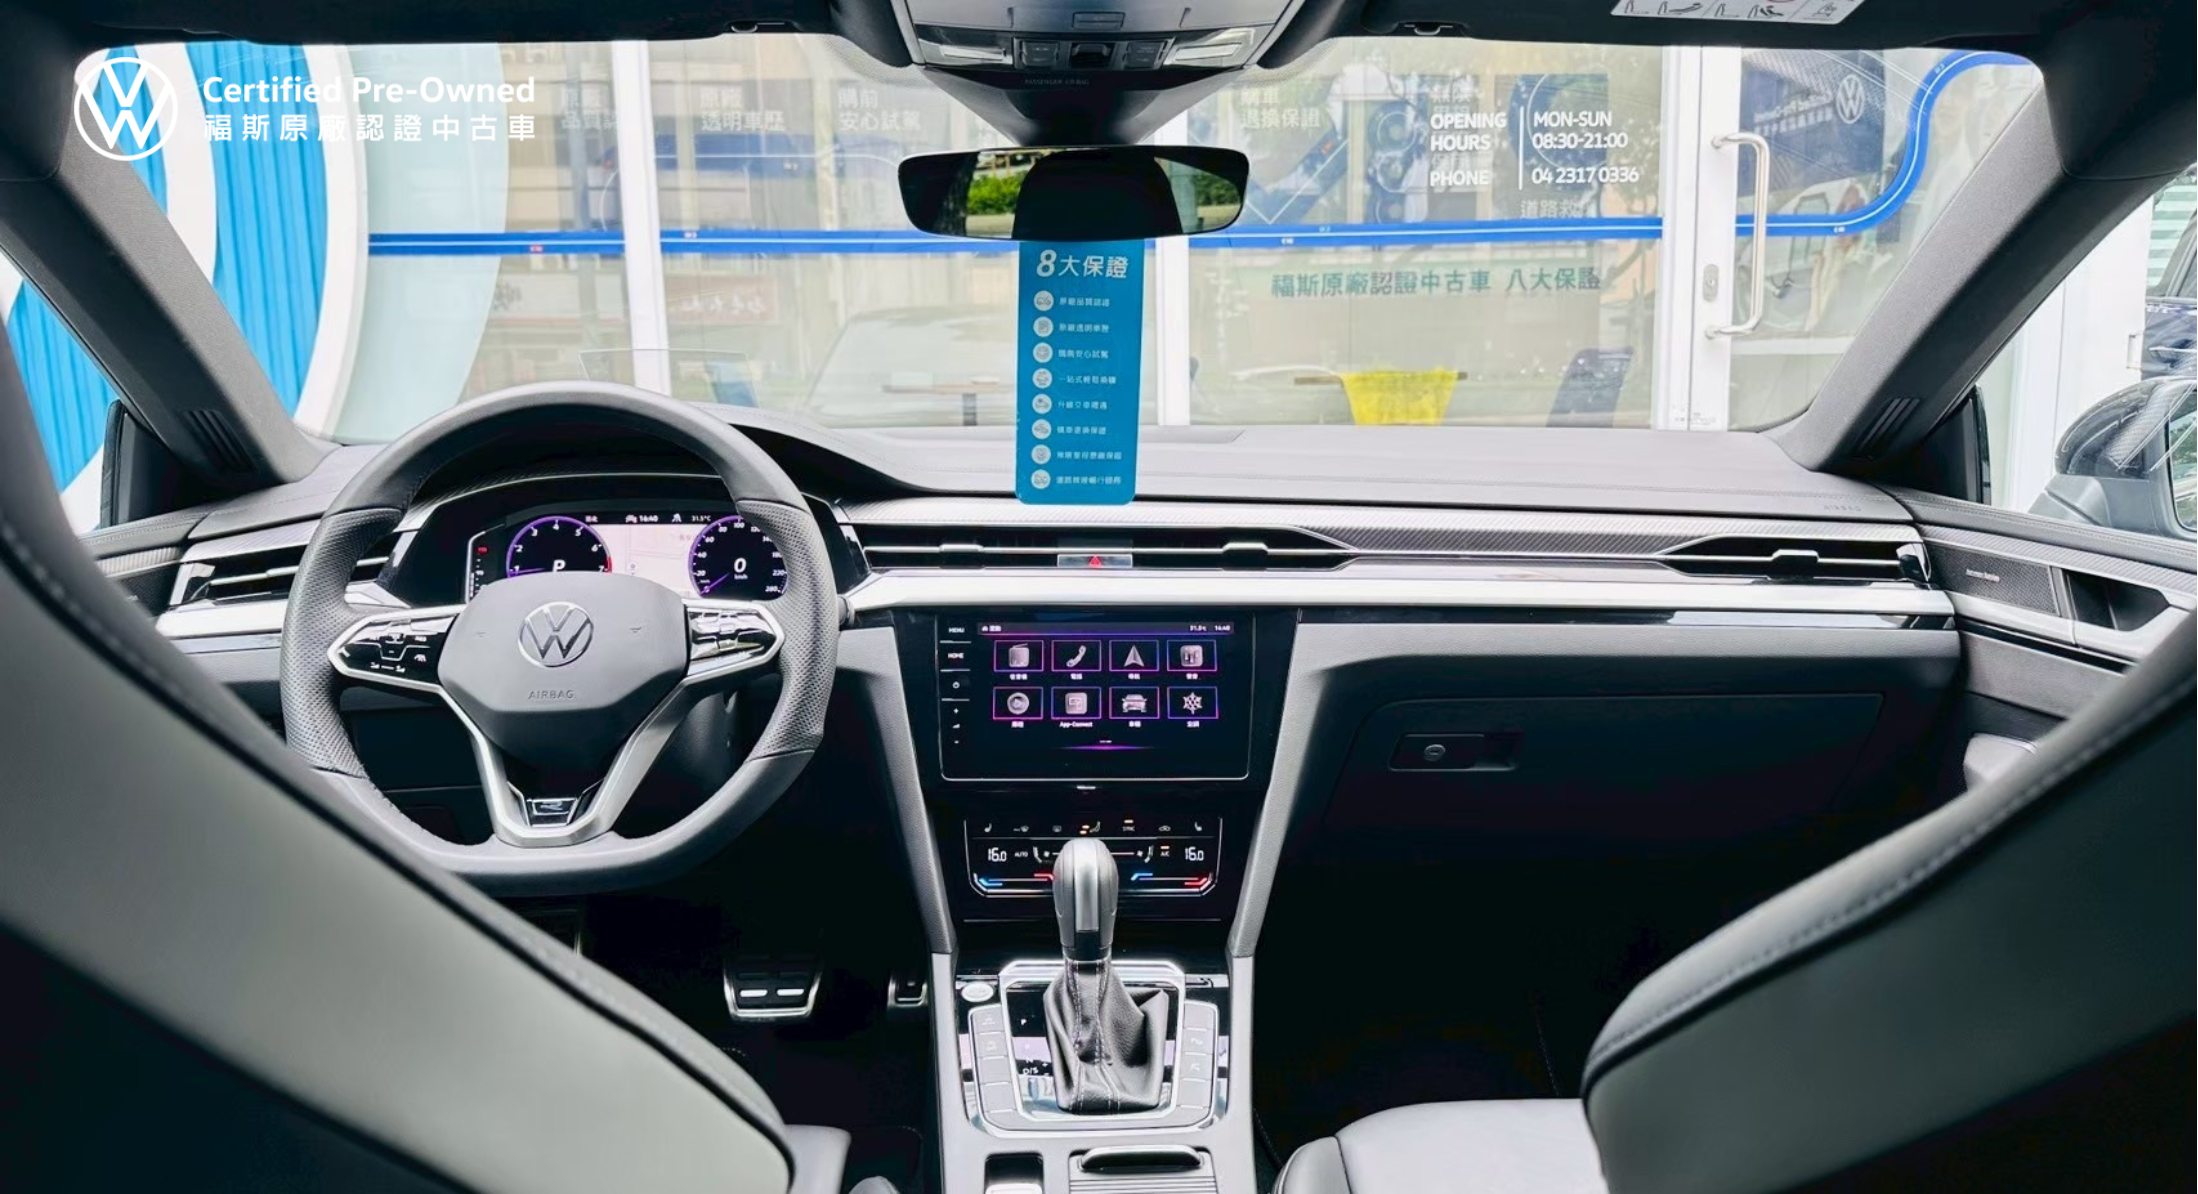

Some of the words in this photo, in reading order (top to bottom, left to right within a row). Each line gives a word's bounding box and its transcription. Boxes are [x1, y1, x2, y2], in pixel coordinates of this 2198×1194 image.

[1430, 112, 1507, 130] OPENING
[1533, 111, 1612, 127] MON-SUN
[1430, 134, 1491, 152] HOURS
[1532, 132, 1628, 149] 08:30-21:00
[1430, 169, 1491, 187] PHONE
[1531, 168, 1553, 184] 04
[1555, 167, 1594, 183] 2317
[1598, 166, 1639, 183] 0336
[1036, 249, 1129, 278] 8大保證
[1271, 270, 1491, 298] 福斯原廠認證中古車
[1505, 266, 1601, 291] 八大保證
[575, 528, 582, 536] 5
[552, 560, 566, 572] P
[734, 558, 747, 573] 0
[528, 690, 575, 700] AIRBAG
[988, 847, 1007, 862] 16.0
[1184, 846, 1204, 861] 16.0
